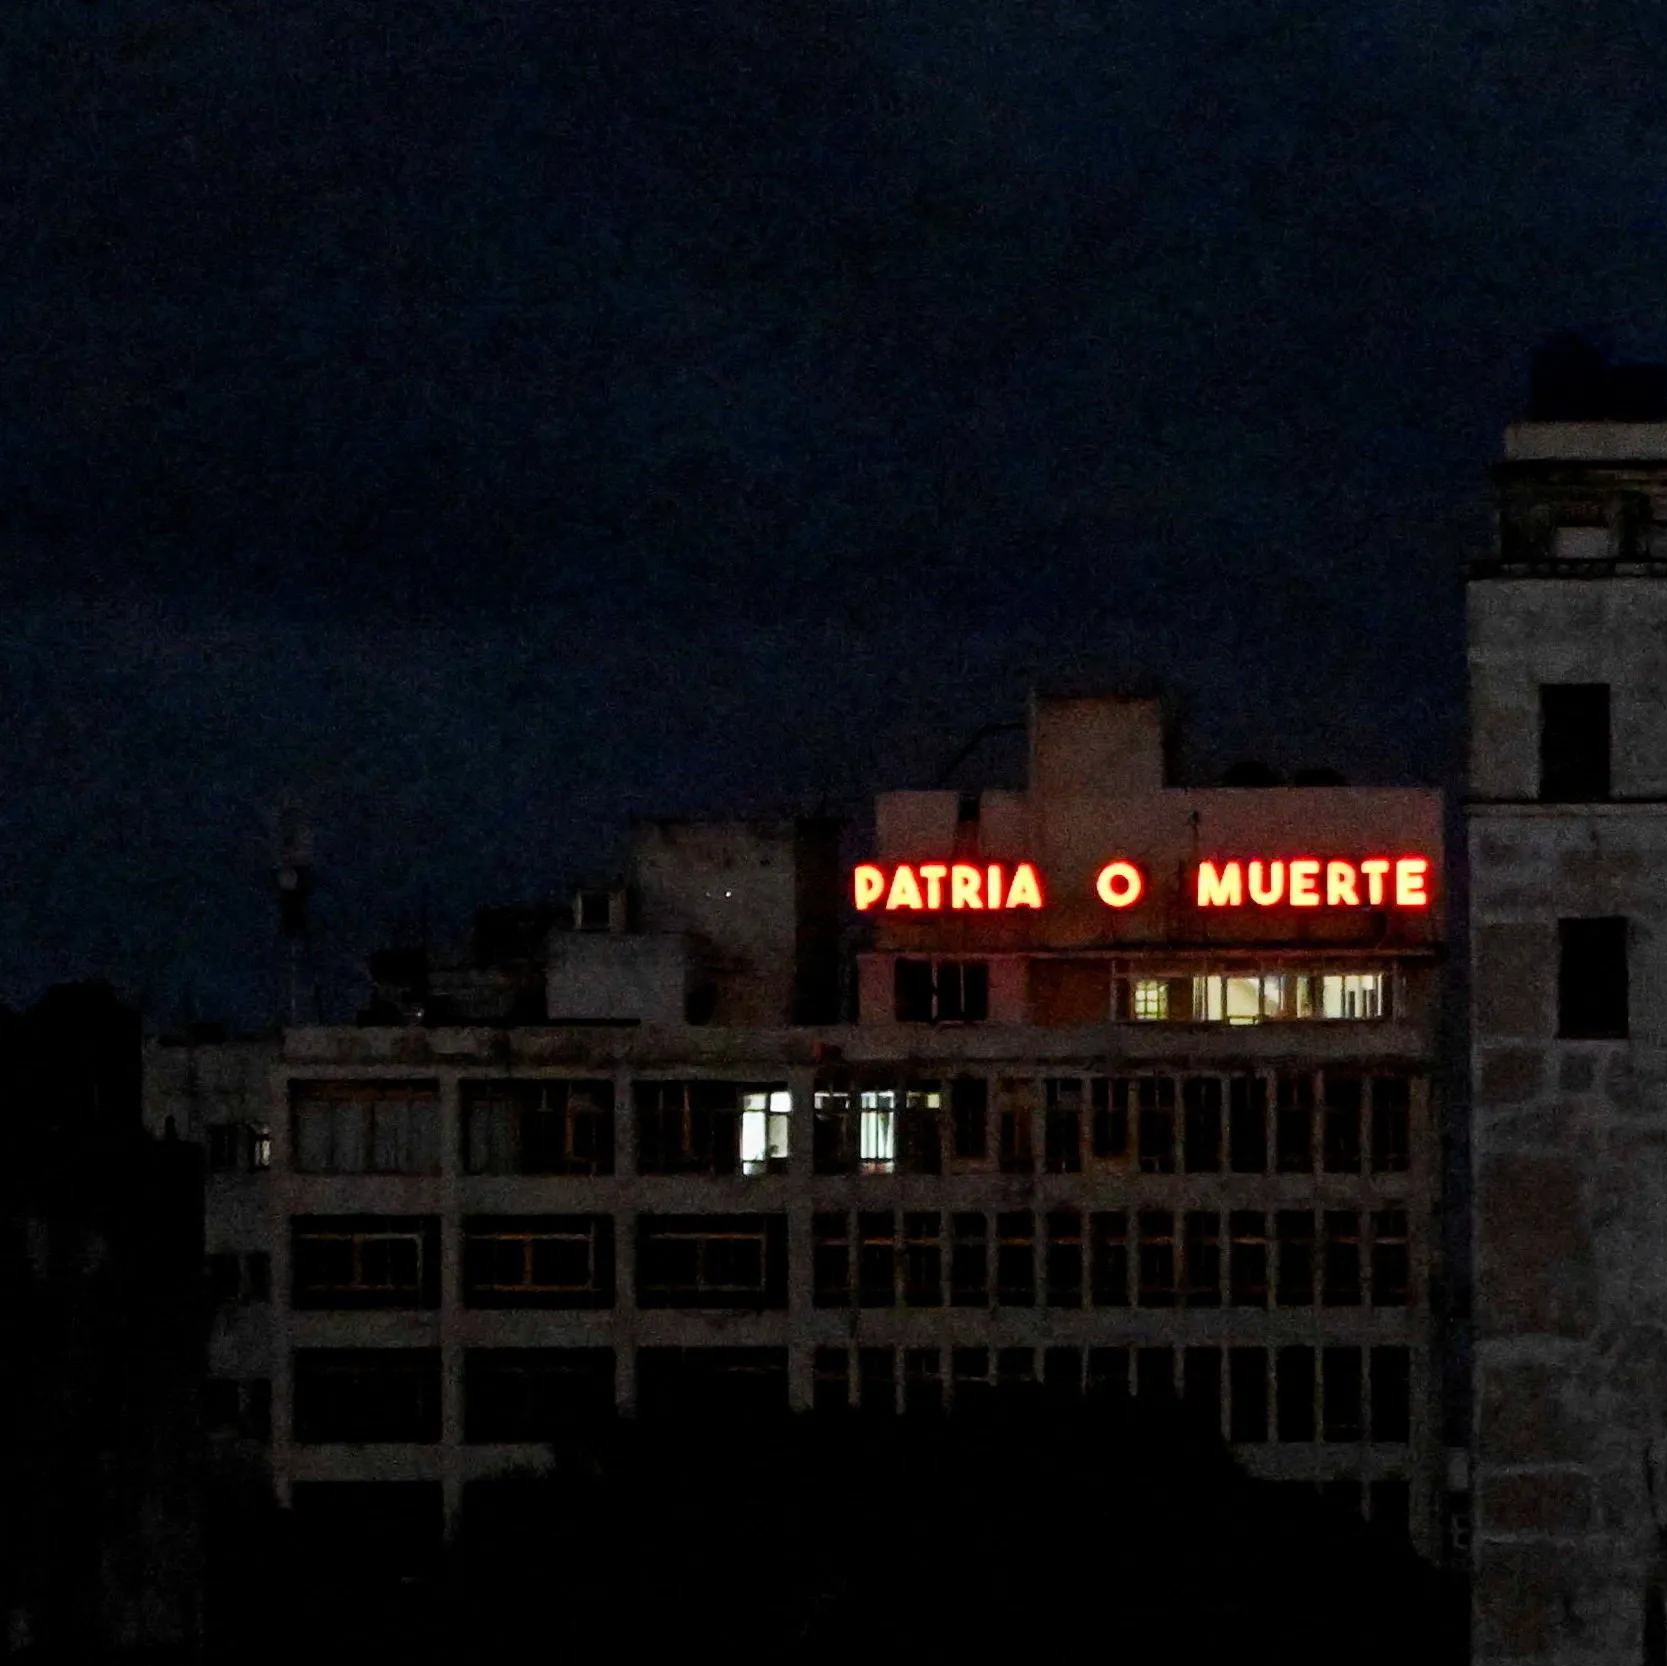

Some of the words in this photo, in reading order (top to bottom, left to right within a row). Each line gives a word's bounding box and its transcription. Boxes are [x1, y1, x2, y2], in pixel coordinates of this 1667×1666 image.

[853, 861, 1044, 911] PATRIA
[1095, 858, 1144, 908] O
[1196, 855, 1431, 907] MUERTE
